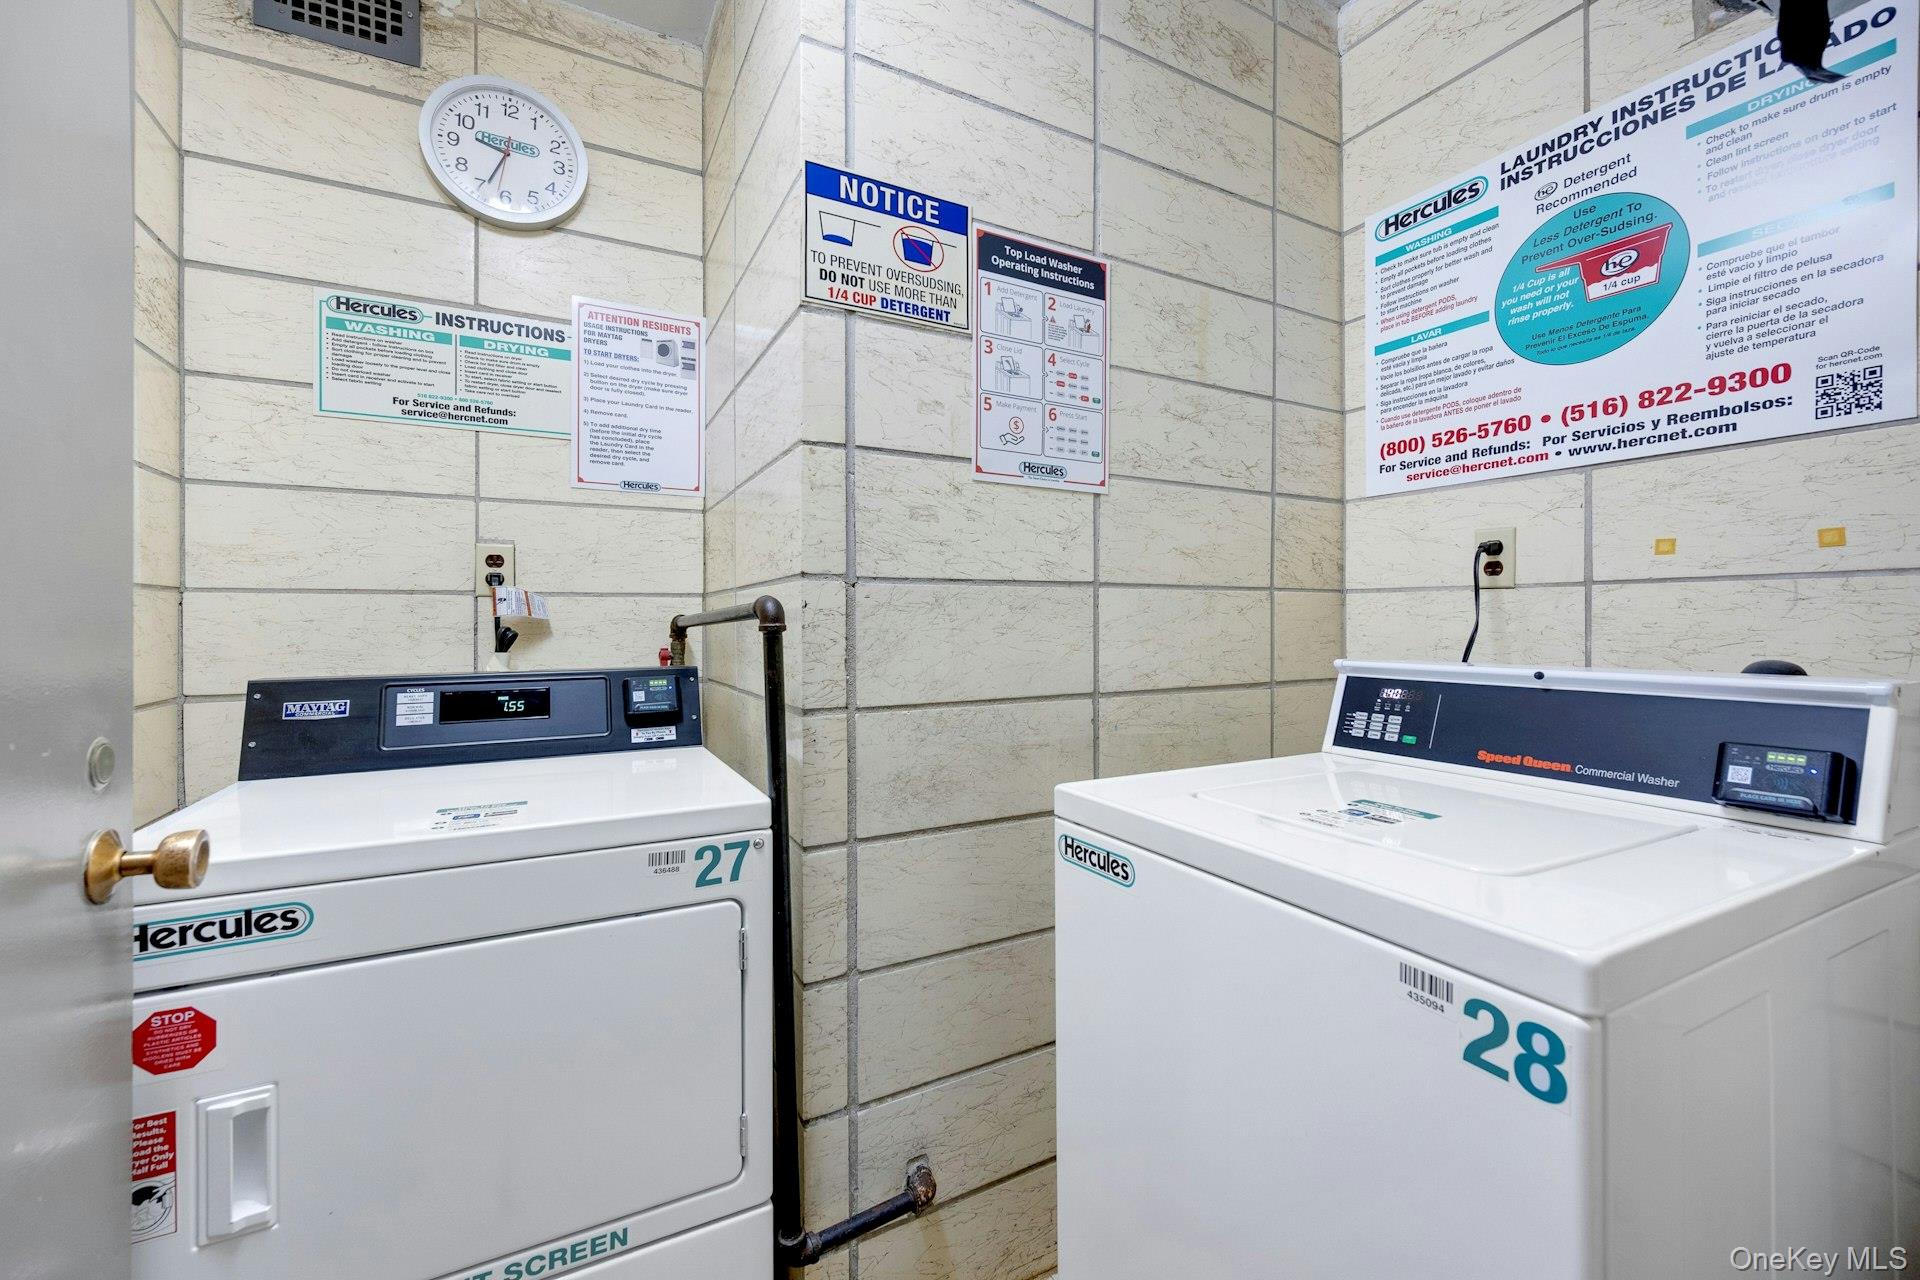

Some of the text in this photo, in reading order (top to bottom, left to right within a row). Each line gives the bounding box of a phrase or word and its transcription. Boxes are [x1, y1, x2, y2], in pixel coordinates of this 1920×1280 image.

[475, 103, 489, 118] 11
[501, 103, 519, 119] 12
[1501, 38, 1782, 174] LAUNDRY INSTRUCTIO
[455, 112, 474, 129] 10
[531, 117, 537, 130] 1
[447, 132, 459, 146] 9
[1501, 97, 1695, 191] INSTRUCCIONES
[1707, 73, 1747, 102] DE
[482, 132, 535, 155] Hercules
[550, 140, 560, 154] 2
[455, 157, 468, 171] 8
[553, 161, 565, 175] 3
[1564, 153, 1631, 188] Detergent
[474, 178, 486, 188] 7
[545, 182, 556, 195] 4
[1537, 167, 1637, 214] Recommended
[500, 191, 512, 204] 6
[528, 191, 539, 204] 5
[839, 175, 939, 224] NOTICE
[1385, 180, 1480, 236] Hercules
[1574, 204, 1596, 219] Use
[1533, 202, 1642, 247] Less Detergent To
[1404, 228, 1452, 253] WASHING
[1522, 212, 1657, 264] Prevent Over-Sudsing.
[1004, 245, 1082, 275] Top Load Washer
[810, 250, 963, 297] TO PREVENT OVERSUDSING,
[992, 255, 1094, 290] Operating Instructions
[1513, 267, 1571, 293] 1/4 Cup is all
[1708, 253, 1832, 292] Limpie el filtro de pelusa
[820, 268, 956, 309] DO NOT USE MORE THAN
[984, 282, 991, 296] 1
[1603, 274, 1641, 291] 1/4 cup
[996, 285, 1037, 302] Add Detergent
[1501, 277, 1580, 309] you need or your
[336, 296, 418, 321] Hercules
[828, 287, 950, 322] 1/4 CUP DETERGENT
[1048, 297, 1056, 311] 2
[1060, 301, 1095, 315] Load Laundry
[1510, 290, 1570, 315] wash will not
[1508, 302, 1574, 326] rinse properly.
[345, 321, 435, 342] WASHING
[436, 312, 565, 342] INSTRUCTIONS
[584, 322, 648, 337] USAGE INSTRUCTIONS
[587, 311, 691, 335] ATTENTION RESIDENTS
[584, 329, 622, 341] FOR MAYTAG
[584, 338, 608, 346] DRYERS
[1411, 328, 1442, 343] LAVAR
[483, 340, 549, 357] DRYING
[593, 350, 610, 358] START
[613, 353, 639, 361] DRYERS:
[984, 340, 993, 354] 3
[996, 343, 1022, 355] Close Lid
[1818, 345, 1880, 362] Scan QR-Code
[1047, 353, 1056, 367] 4
[1059, 355, 1090, 369] Select Cycle
[1829, 352, 1882, 368] hercnet.com
[393, 397, 516, 417] For Service and Refunds:
[984, 397, 992, 411] 5
[996, 400, 1037, 414] Make Payment
[1380, 362, 1792, 460] (800) 526-5760 (516) 822-9300
[402, 408, 508, 425] service@hercnet.com
[1048, 408, 1057, 421] 6
[1059, 411, 1087, 421] Press Start
[1380, 395, 1792, 474] For Service and Refunds: Por Servicios y Reembolsos:
[1407, 422, 1737, 482] service@hercnet.com www.hercnet.com
[1023, 462, 1064, 477] Hercules
[623, 481, 658, 490] Hercules
[287, 702, 345, 714] MAYTAG
[1477, 750, 1680, 787] Speed Queen Commercial Washer
[695, 840, 750, 888] 27
[1065, 836, 1129, 880] Hercules
[653, 866, 680, 874] 436488
[1407, 990, 1444, 1013] 435094
[151, 1011, 195, 1027] STOP
[1463, 998, 1567, 1104] 28
[148, 1118, 167, 1127] Best
[152, 1151, 174, 1162] Only
[154, 1144, 169, 1152] the
[151, 1161, 168, 1171] Full
[504, 1227, 628, 1280] SCREEN
